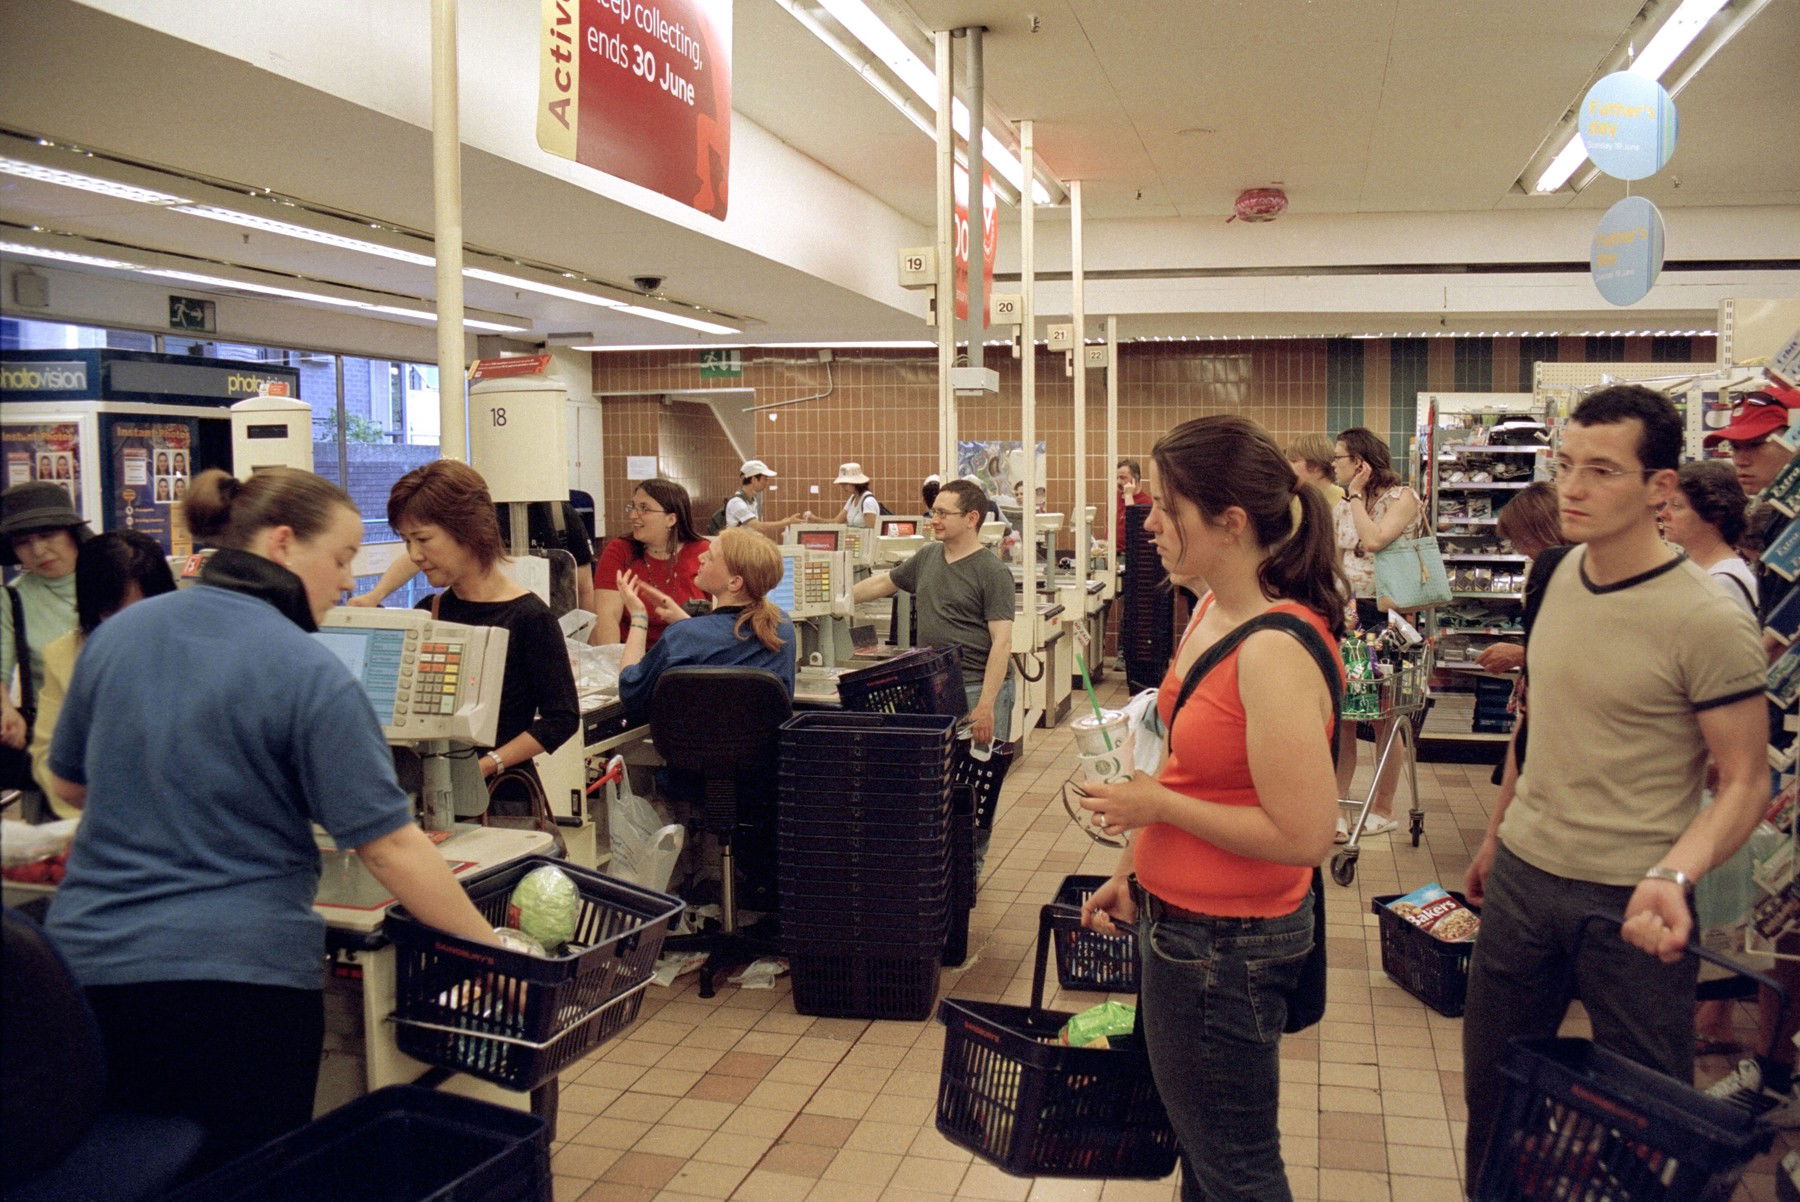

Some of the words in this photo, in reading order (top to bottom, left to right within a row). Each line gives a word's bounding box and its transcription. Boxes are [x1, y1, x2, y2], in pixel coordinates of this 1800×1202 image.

[634, 4, 703, 70] collecting,
[548, 0, 572, 130] Activ
[587, 26, 629, 69] ends
[632, 44, 656, 82] 30
[659, 62, 695, 106] June
[907, 258, 922, 270] 19
[998, 302, 1013, 312] 20
[1054, 331, 1065, 340] 21
[1, 367, 87, 388] hotovision
[490, 408, 507, 427] 18
[1406, 900, 1457, 926] Bakers
